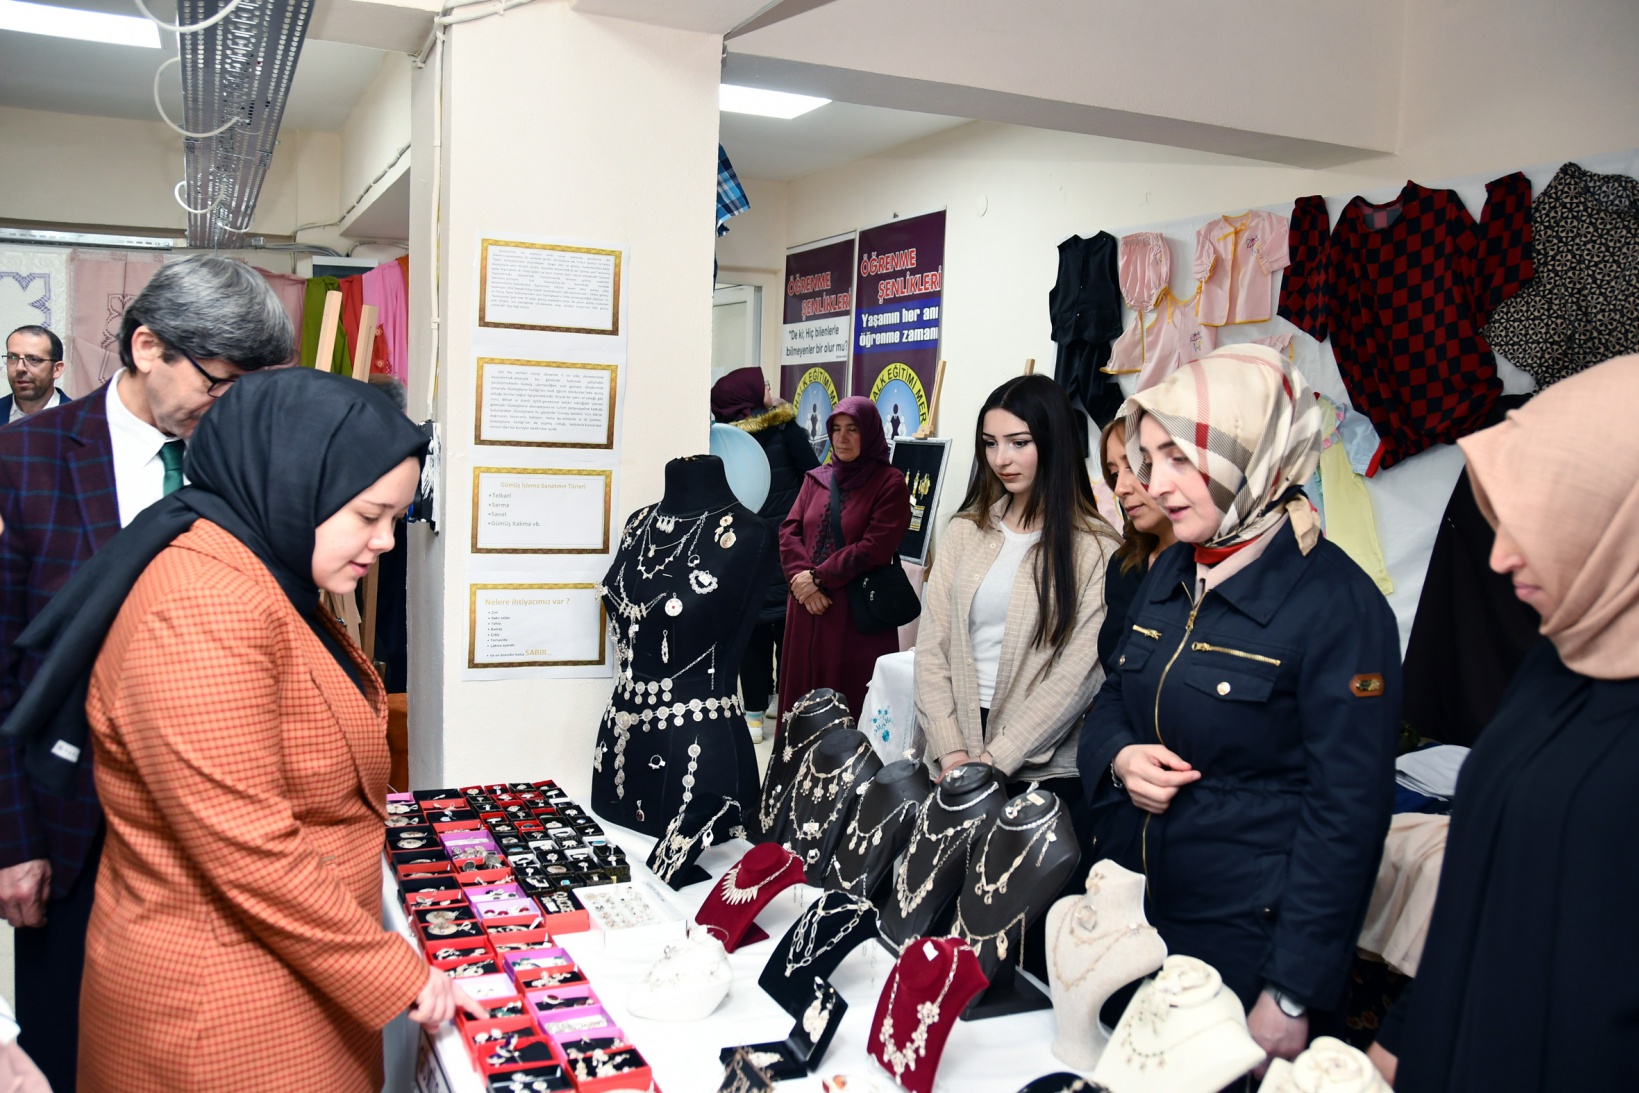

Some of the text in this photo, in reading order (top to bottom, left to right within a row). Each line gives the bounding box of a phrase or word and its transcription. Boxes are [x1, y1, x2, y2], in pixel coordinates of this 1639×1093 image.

[860, 248, 917, 277] ÖĞRENME
[788, 271, 831, 296] ÖĞRENME
[878, 265, 942, 304] ŞENLİKLERİ
[801, 287, 852, 321] ŞENLİKLERİ
[861, 306, 939, 327] Yaşamın her anı
[805, 328, 814, 340] Hiç
[815, 324, 840, 337] bilenlerle
[859, 327, 939, 348] öğrenme zamanı
[786, 344, 815, 358] bilmeyenler
[824, 341, 835, 353] olur
[794, 378, 808, 409] HALK
[808, 369, 832, 391] EĞİTİMİ
[870, 375, 886, 402] ALK
[887, 364, 918, 391] EĞİTİMİ
[521, 481, 540, 489] İşleme
[511, 598, 551, 607] ihtiyacımız
